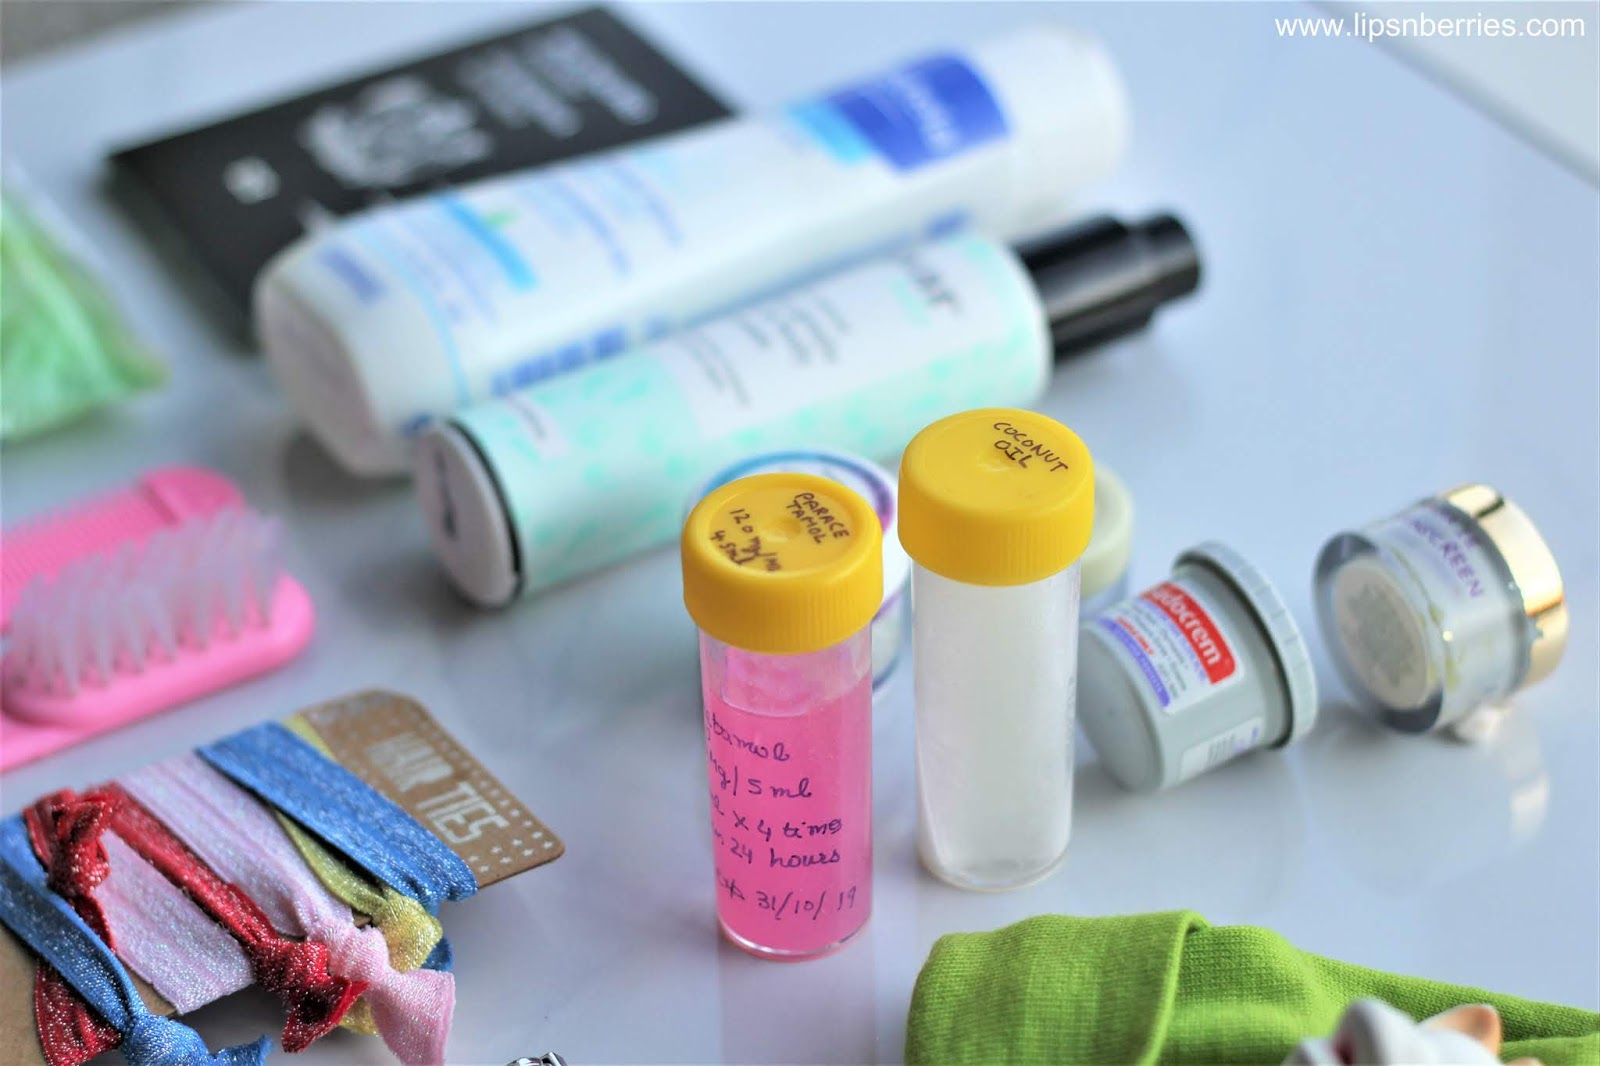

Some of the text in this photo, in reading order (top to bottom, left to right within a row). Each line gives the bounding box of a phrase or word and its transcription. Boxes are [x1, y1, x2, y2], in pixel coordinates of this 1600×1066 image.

[993, 422, 1069, 472] COCONUT
[994, 440, 1032, 468] OIL
[786, 500, 826, 544] TAMOL
[793, 492, 850, 538] PARACE
[415, 780, 510, 844] TIES
[757, 819, 772, 842] 4
[730, 837, 753, 864] 24
[770, 848, 841, 868] hours
